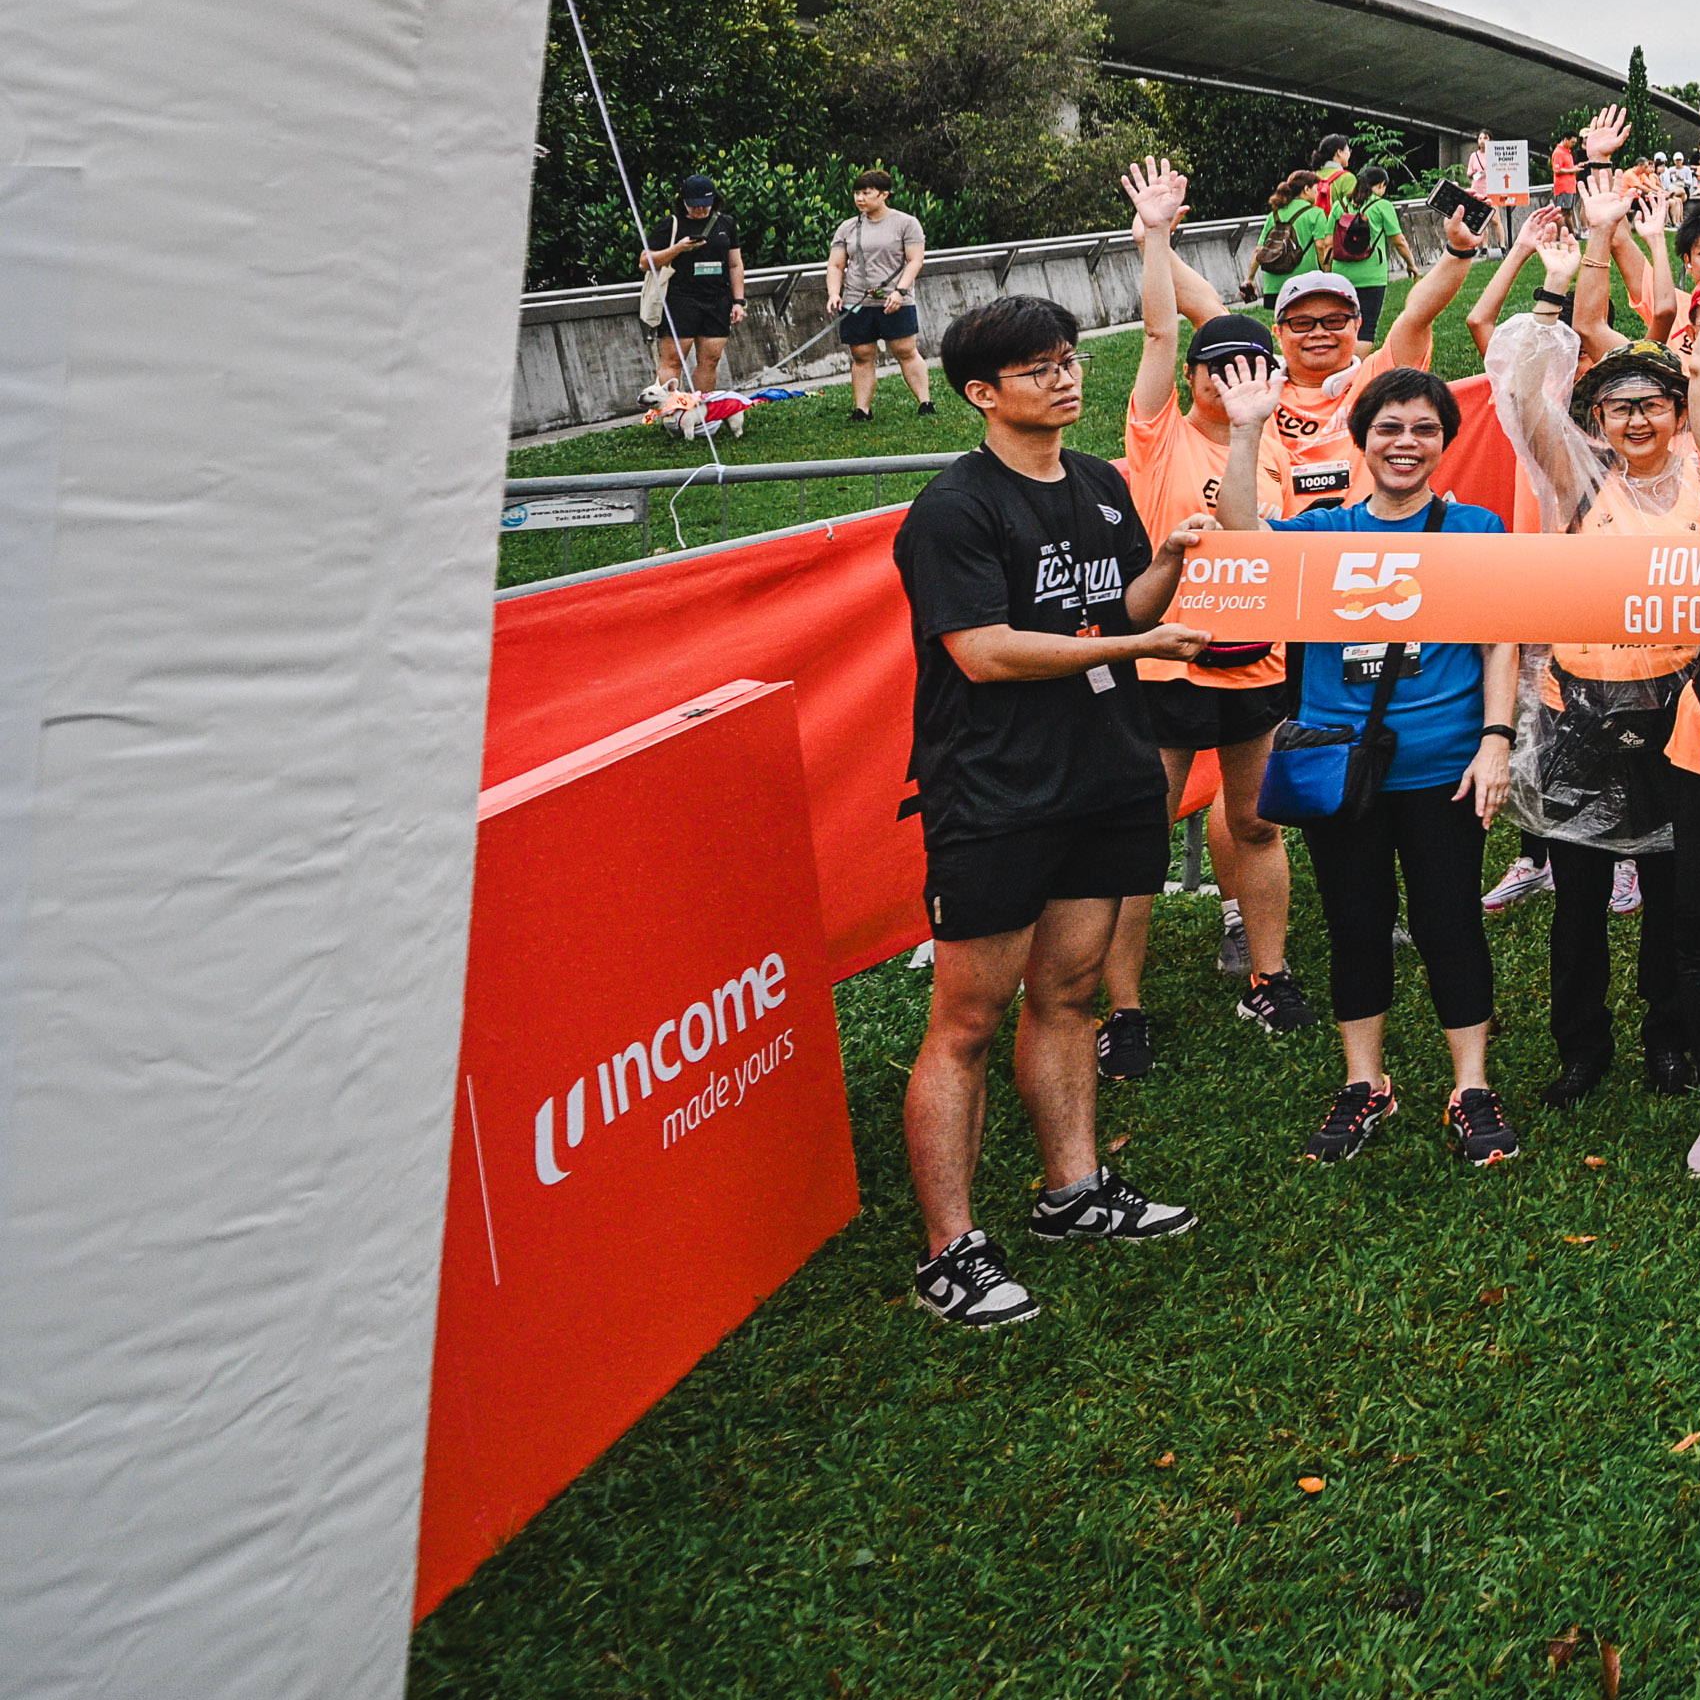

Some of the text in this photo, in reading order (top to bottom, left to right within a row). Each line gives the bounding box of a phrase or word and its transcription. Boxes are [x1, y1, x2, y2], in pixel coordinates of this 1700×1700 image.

[1299, 475, 1336, 490] 10008
[1177, 590, 1267, 613] ade yours
[1624, 595, 1663, 634] GO
[1361, 661, 1384, 675] 110
[597, 952, 786, 1126] income
[663, 1028, 794, 1150] made yours
